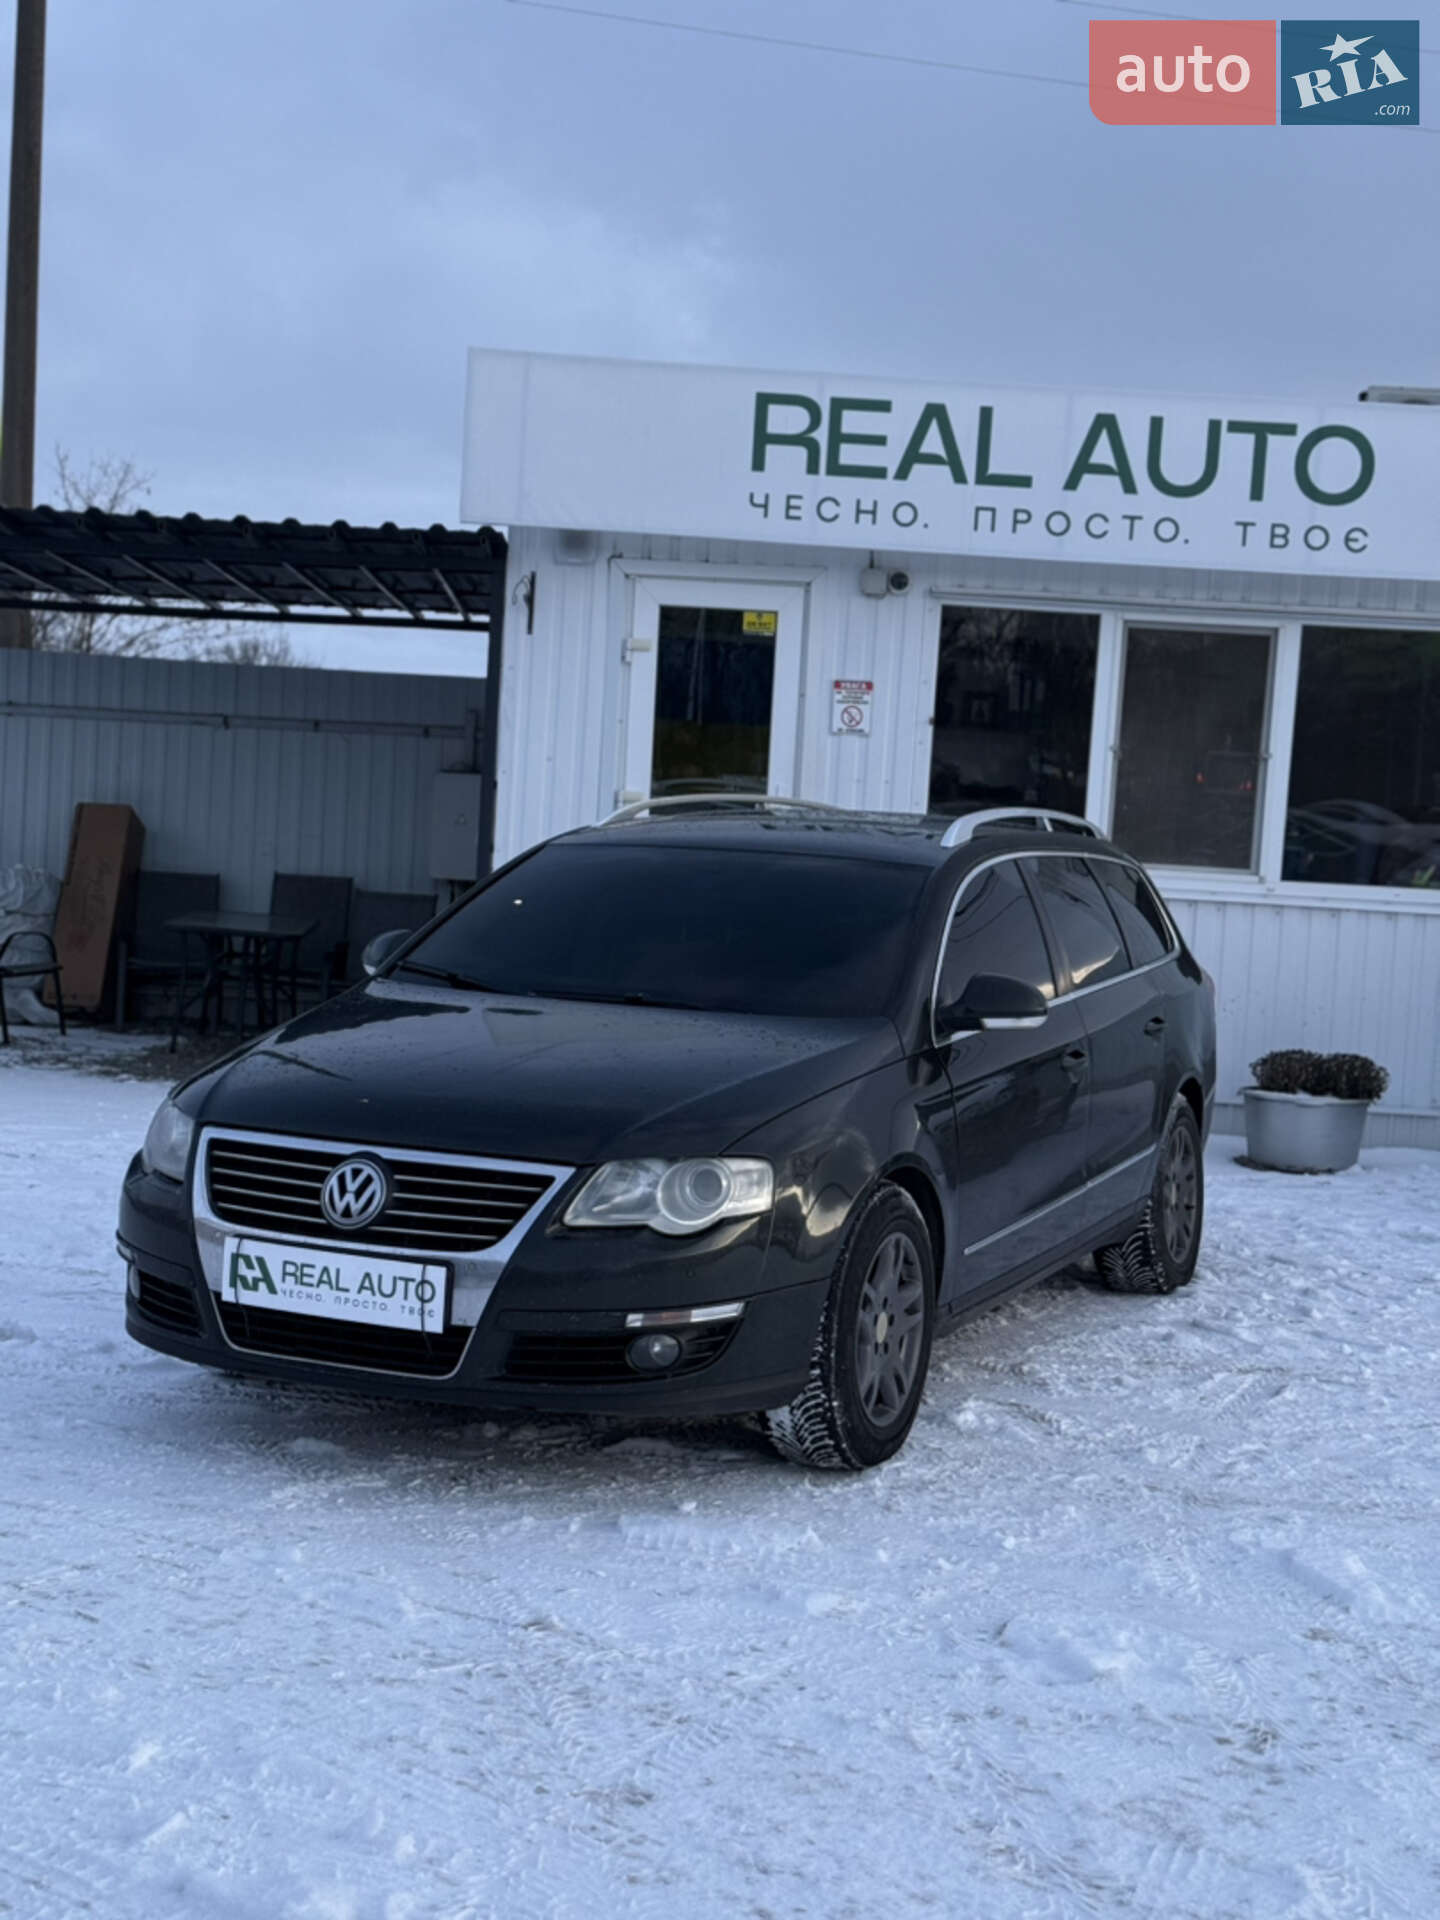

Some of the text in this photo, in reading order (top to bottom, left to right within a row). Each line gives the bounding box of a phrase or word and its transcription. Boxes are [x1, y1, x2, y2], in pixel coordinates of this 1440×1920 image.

[751, 392, 1376, 507] REAL AUTO
[749, 492, 1369, 554] ЧЕСНО. ПРОСТО. ТВОЄ
[281, 1260, 436, 1304] REAL AUTO
